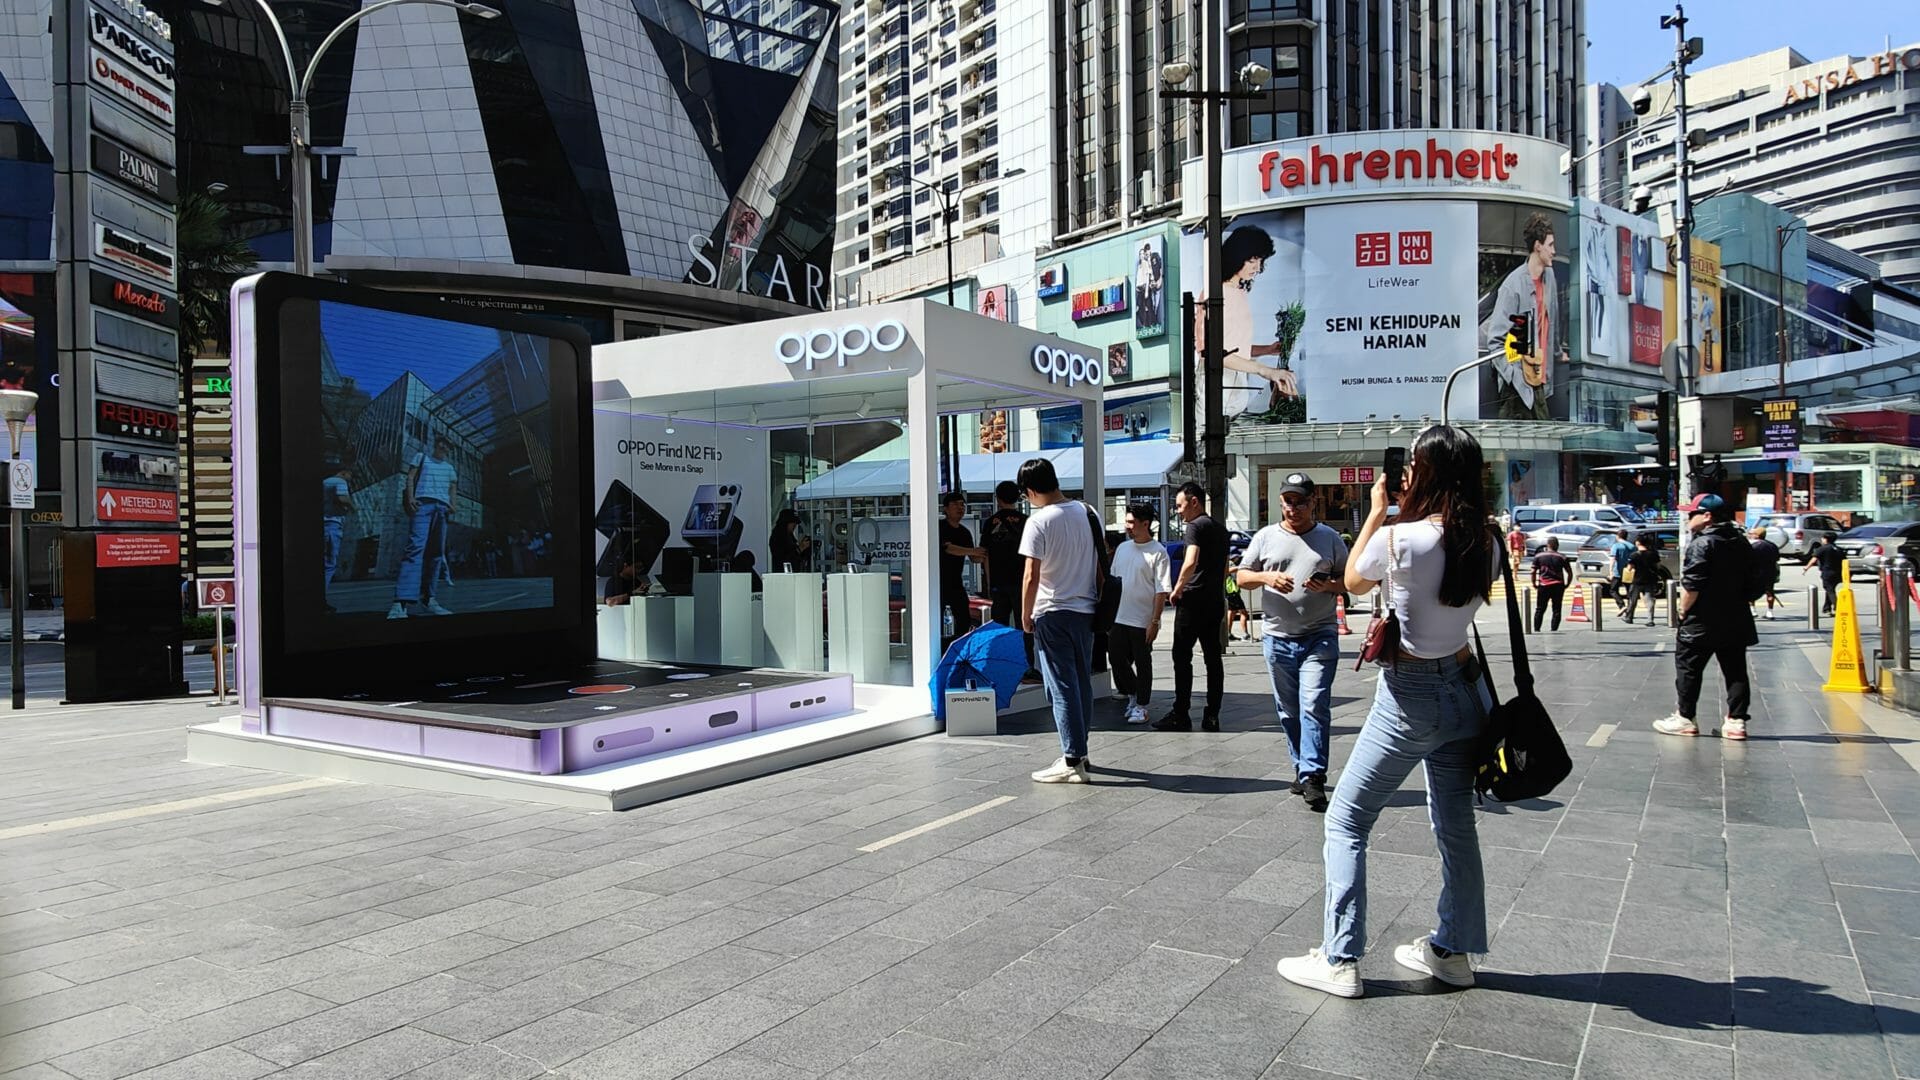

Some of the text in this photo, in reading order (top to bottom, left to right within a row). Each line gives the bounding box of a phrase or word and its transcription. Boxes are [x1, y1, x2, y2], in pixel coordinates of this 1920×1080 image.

[95, 12, 176, 81] PARKSON
[1783, 65, 1859, 106] ANSA
[1631, 133, 1662, 150] HOTEL
[120, 150, 159, 186] PADINI
[1259, 138, 1509, 192] fahrenheit
[1402, 235, 1426, 247] UNI
[1402, 249, 1429, 262] QLO
[688, 233, 827, 311] STAR
[1368, 277, 1420, 289] LifeWear
[114, 280, 166, 313] Mercato
[477, 298, 520, 310] spectrum
[1081, 304, 1116, 318] BOOKSTORE
[1136, 324, 1162, 338] FASHION
[1325, 315, 1461, 332] SENI KEHIDUPAN
[1363, 334, 1427, 350] HARIAN
[1635, 335, 1660, 350] OUTLET
[1111, 367, 1123, 375] SPA
[1342, 375, 1447, 386] MUSIM BUNGA & PANAS 2023
[102, 402, 177, 432] REDBOX
[1769, 411, 1792, 421] FAIR
[121, 424, 162, 437] PLUS
[618, 440, 722, 461] OPPO Find N2 Flip
[640, 461, 654, 471] See
[655, 463, 673, 472] More
[674, 464, 680, 473] in
[687, 464, 704, 475] Snap
[121, 496, 173, 509] METERED TAXI
[1840, 616, 1850, 648] CAUTION
